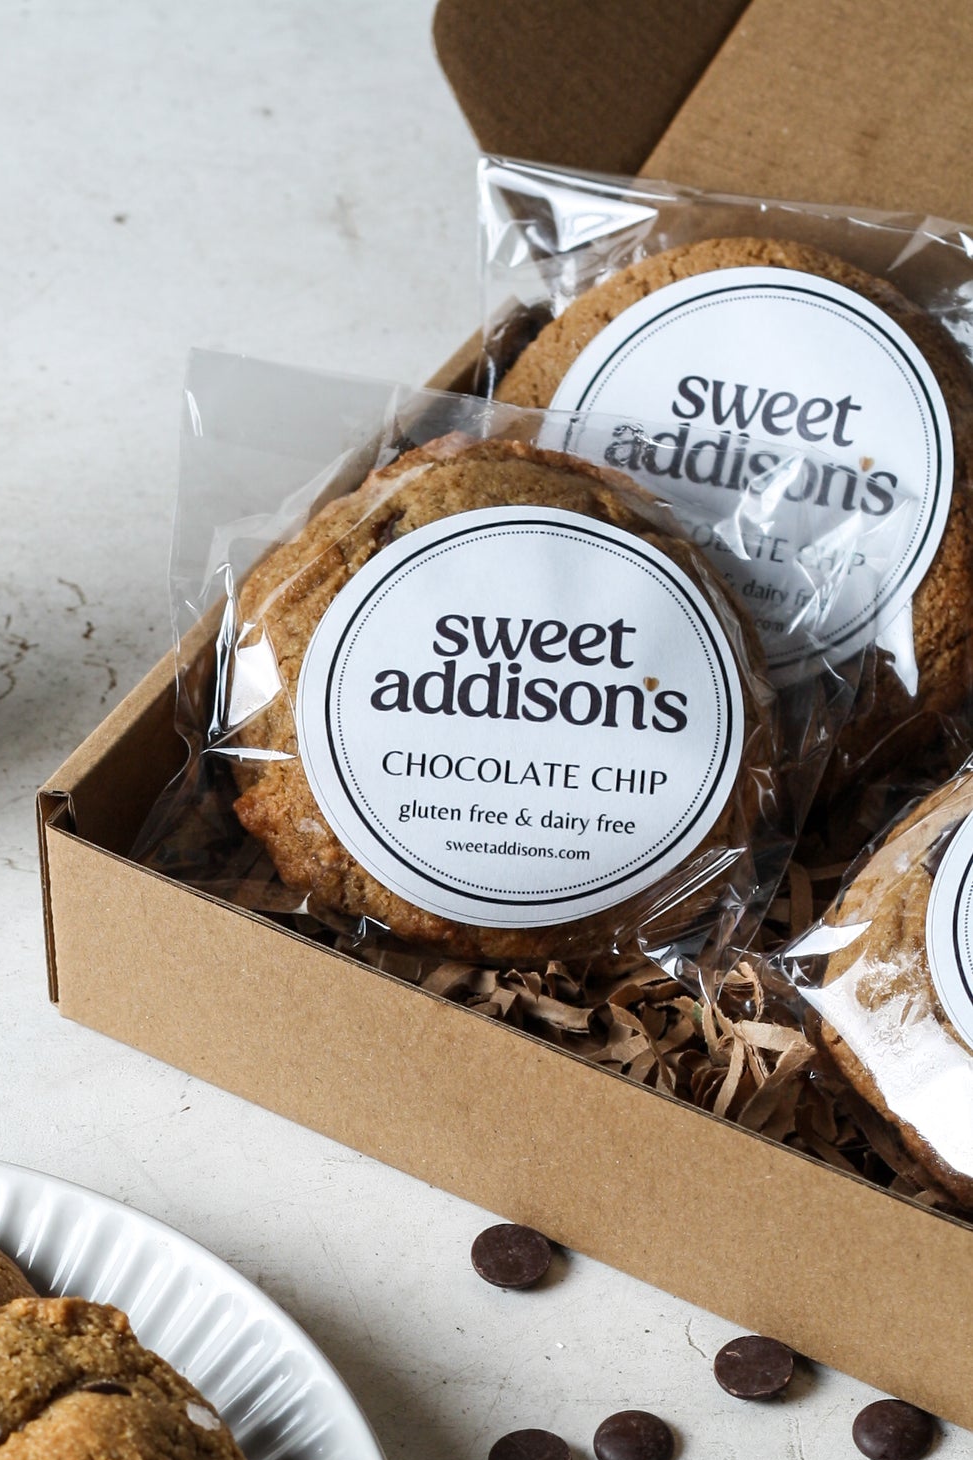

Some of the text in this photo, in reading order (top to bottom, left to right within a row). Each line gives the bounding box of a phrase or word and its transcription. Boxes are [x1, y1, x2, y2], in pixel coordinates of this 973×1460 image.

[672, 375, 862, 447] sweet
[433, 614, 637, 669] sweet
[382, 750, 668, 795] CHOCOLATE CHIP
[398, 799, 636, 836] gluten free & dairy free
[445, 839, 590, 861] sweetaddisons.com
